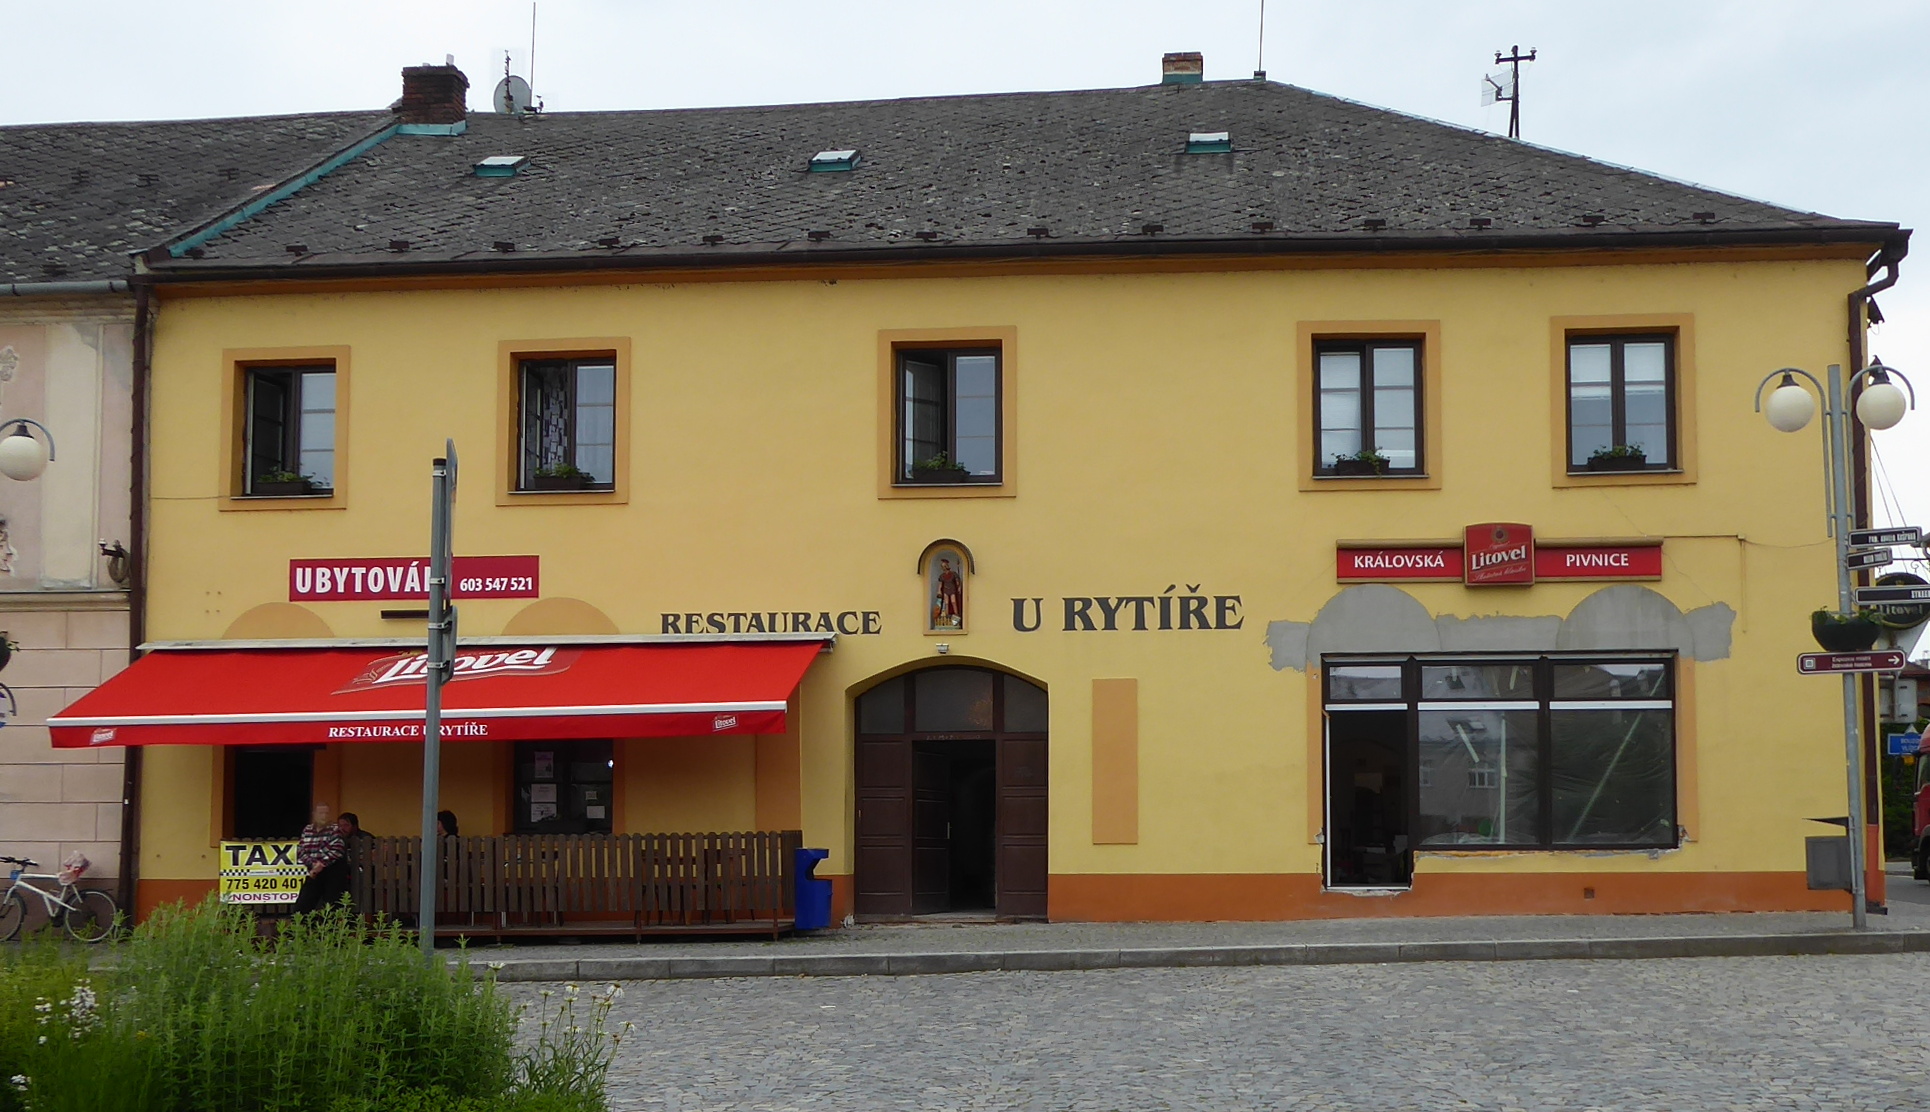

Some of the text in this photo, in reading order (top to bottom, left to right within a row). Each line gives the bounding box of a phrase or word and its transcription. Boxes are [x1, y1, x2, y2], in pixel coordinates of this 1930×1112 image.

[1354, 550, 1445, 569] KRÁLOVSKÁ
[1471, 545, 1526, 570] Litovel
[1565, 552, 1630, 567] PIVNICE
[295, 560, 533, 594] UBYTOVÁ 603 547 521
[1010, 583, 1245, 633] U RYTÍŘE
[660, 610, 882, 636] RESTAURACE
[328, 725, 420, 738] RESTAURACE
[440, 722, 488, 736] RYTÍŘE
[226, 879, 249, 889] 775
[254, 878, 277, 889] 420
[232, 893, 299, 901] NONSTOP
